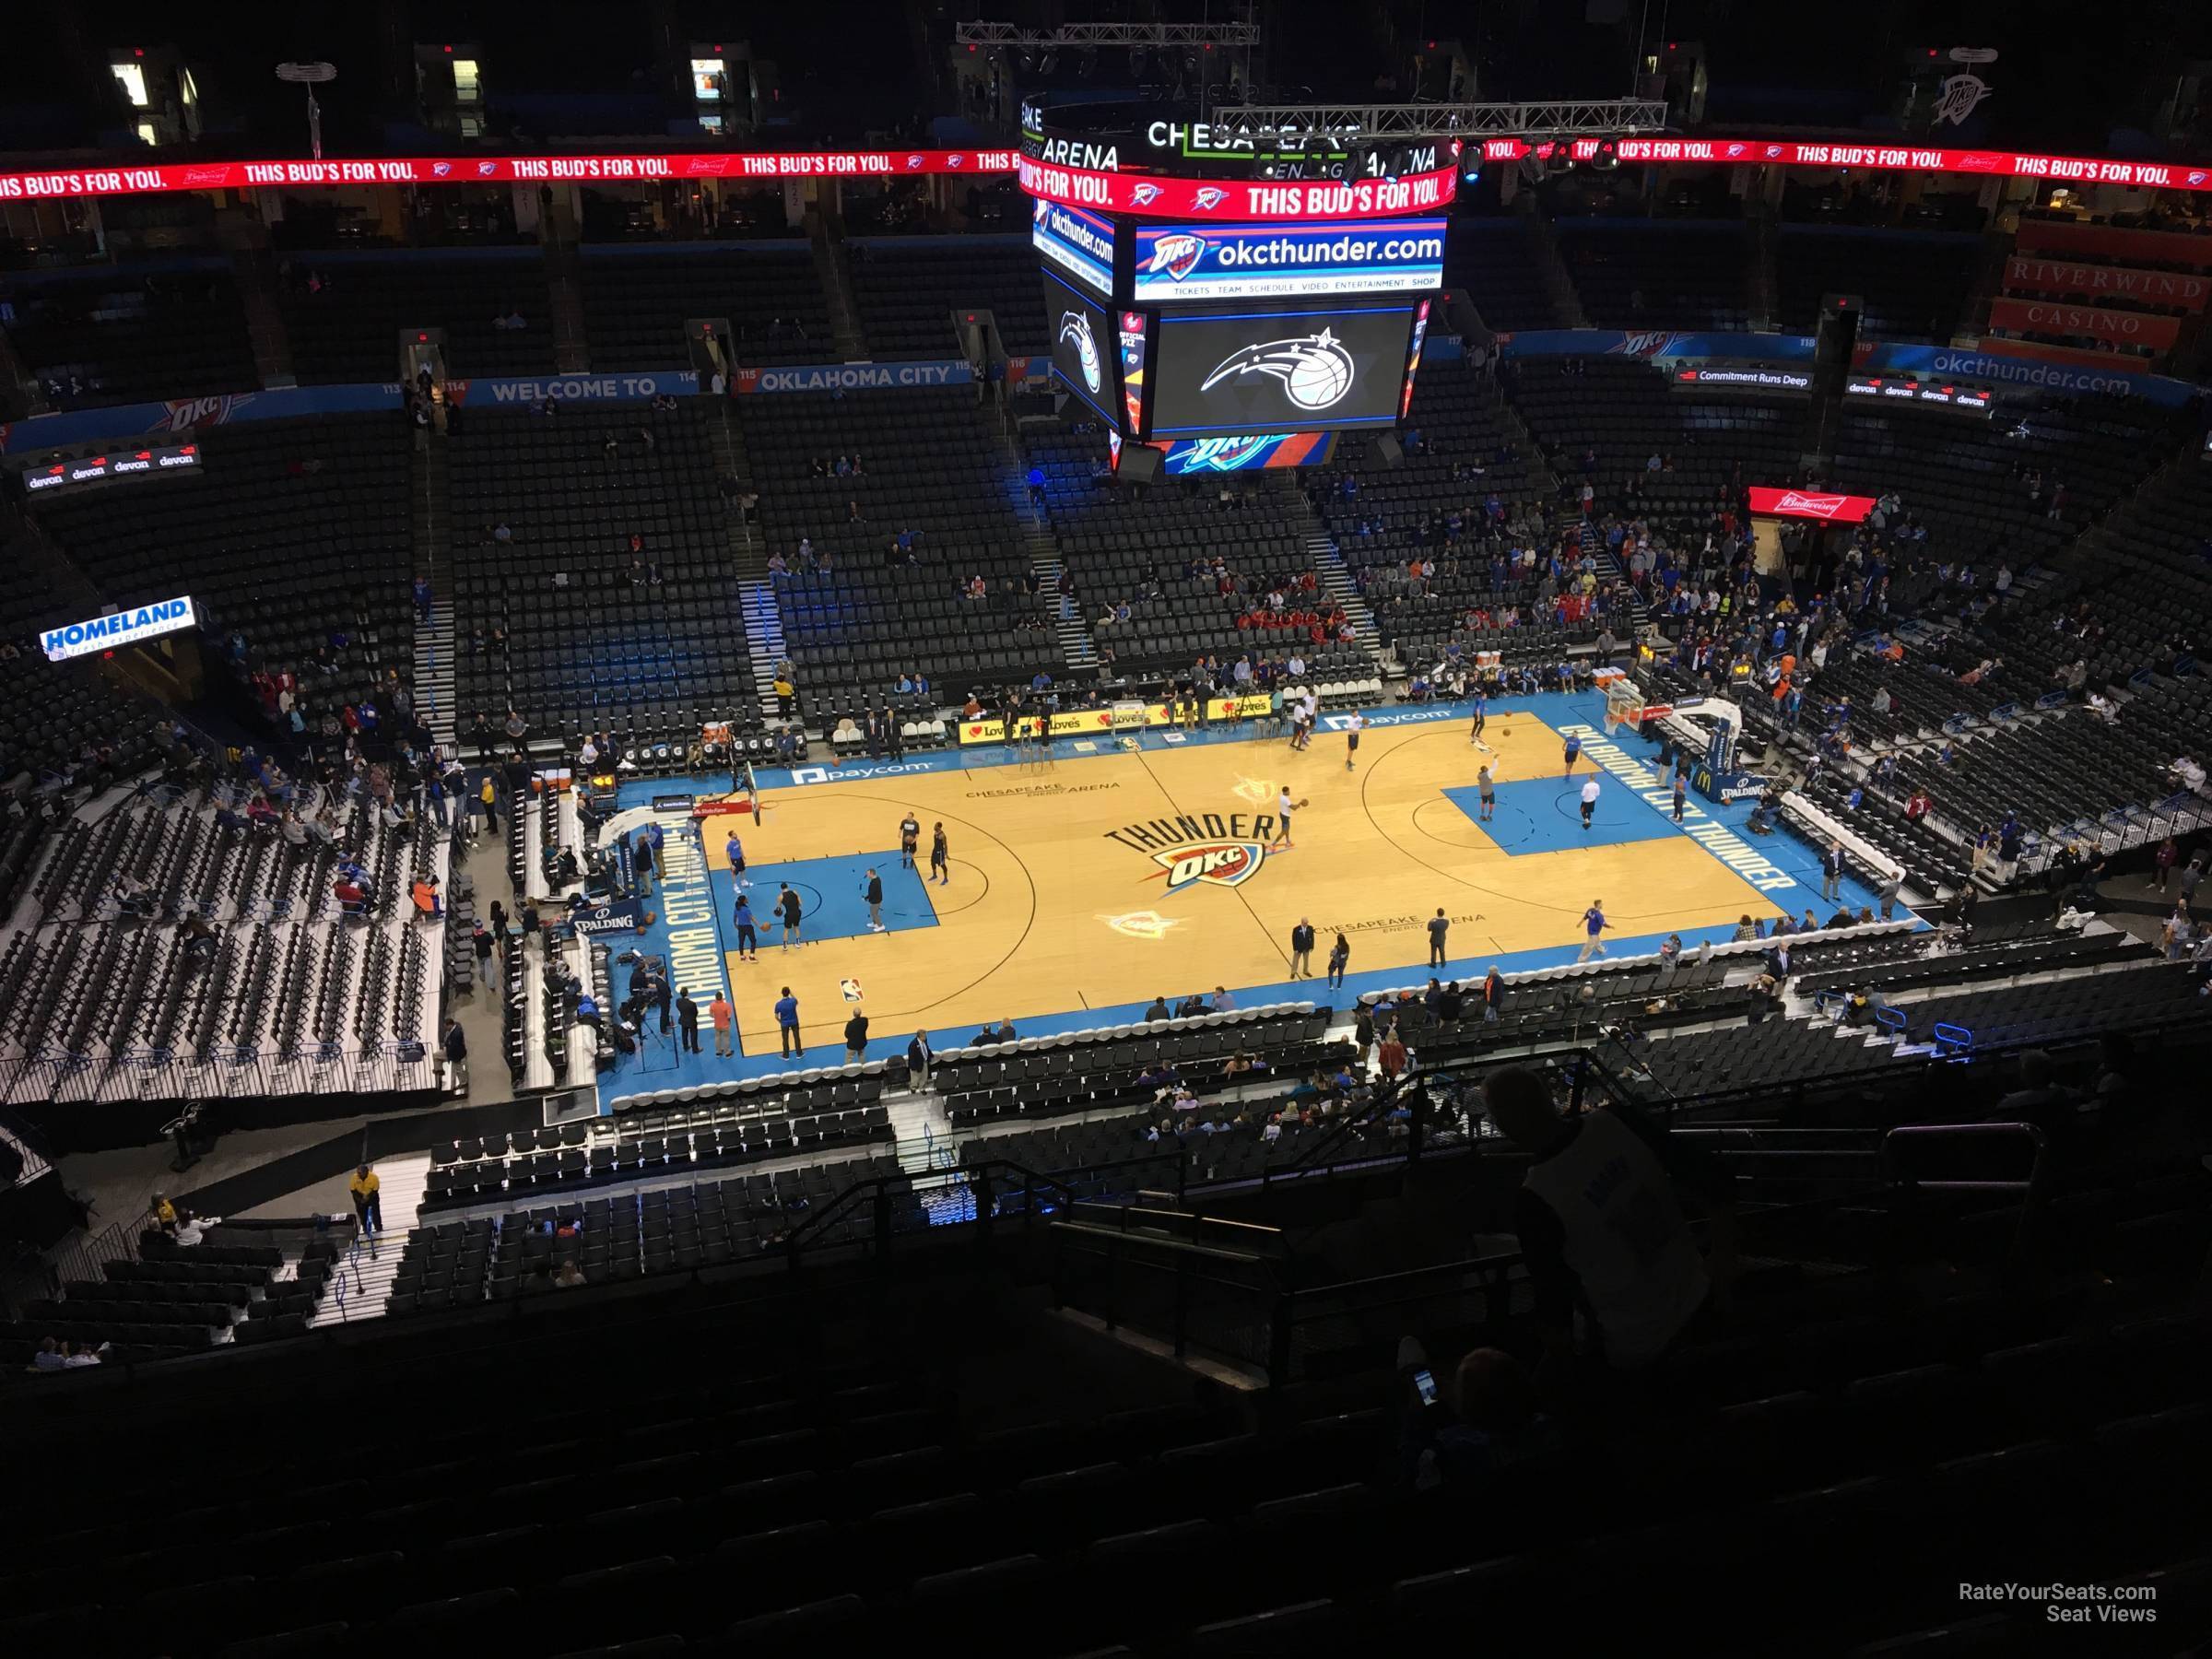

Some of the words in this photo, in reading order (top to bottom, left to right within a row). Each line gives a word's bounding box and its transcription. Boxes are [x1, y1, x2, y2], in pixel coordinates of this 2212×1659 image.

[1042, 137, 1119, 172] ARENA
[1489, 142, 1516, 157] YOU.
[1619, 143, 1651, 158] UD'S
[1653, 143, 1681, 158] FOR
[1685, 144, 1714, 159] YOU.
[1797, 147, 1829, 162] THIS
[1831, 148, 1876, 164] BUD'S
[1878, 150, 1908, 166] FOR
[1912, 152, 1944, 168] YOU.
[512, 160, 548, 177] THIS
[552, 159, 600, 176] BUD'S
[604, 159, 633, 175] FOR
[637, 159, 672, 175] YOU.
[743, 157, 776, 173] THIS
[781, 157, 824, 172] BUD'S
[829, 156, 856, 171] FOR
[860, 156, 893, 171] YOU.
[977, 154, 1008, 170] THIS
[1366, 146, 1435, 176] ANA
[245, 165, 284, 182] THIS
[288, 164, 339, 182] BUD'S
[343, 163, 375, 180] FOR
[379, 162, 418, 180] YOU.
[2016, 158, 2048, 173] THIS
[2051, 160, 2098, 178] BUD'S
[2100, 164, 2132, 181] FOR
[2136, 167, 2171, 184] YOU.
[0, 177, 22, 196] IS
[25, 174, 82, 194] BUD'S
[85, 172, 122, 192] FOR
[124, 171, 167, 188] YOU.
[1043, 169, 1069, 198] FOR
[1071, 174, 1113, 206] YOU.
[1248, 187, 1301, 215] THIS
[1308, 186, 1371, 214] BUD'S
[1376, 183, 1410, 210] FOR
[1414, 177, 1440, 205] YOU.
[1052, 208, 1113, 264] okcthunder.com
[1148, 237, 1197, 273] OKC
[1218, 236, 1442, 266] okcthunder.com
[1174, 286, 1210, 296] TICKETS
[1218, 285, 1242, 294] TEAM
[1249, 283, 1296, 293] SCHEDULE
[1302, 281, 1328, 291] VIDEO
[1335, 278, 1406, 289] ENTERTAINMENT
[1412, 277, 1435, 288] SHOP
[2013, 263, 2201, 298] RIVERWIND
[2028, 306, 2139, 334] CASINO
[1800, 337, 1816, 347] 118
[1856, 343, 1873, 353] 119
[1010, 359, 1026, 369] 116
[1935, 353, 2132, 394] okcthunder.com
[678, 372, 697, 382] 114
[740, 371, 757, 380] 115
[760, 369, 893, 391] OKLAHOMA
[899, 366, 950, 384] CITY
[1700, 371, 1758, 382] Commitment
[1759, 373, 1782, 383] Runs
[1783, 375, 1808, 388] Deep
[382, 383, 400, 394] 113
[492, 378, 618, 402] WELCOME
[622, 378, 656, 395] TO
[1849, 383, 1877, 394] devon
[1886, 387, 1913, 397] devon
[1922, 391, 1949, 402] devon
[1958, 395, 1985, 406] devon
[168, 395, 218, 432] OKC
[115, 461, 149, 472] devon
[159, 455, 194, 466] devon
[29, 475, 64, 488] devon
[73, 466, 105, 480] devon
[1783, 497, 1838, 511] Budweiser
[46, 600, 187, 651] HOMELAND
[70, 640, 104, 656] fresh
[110, 621, 180, 645] experience
[983, 725, 1017, 736] Lovs
[828, 761, 928, 781] paycom
[966, 783, 1063, 798] CHESAPEAKE
[1068, 782, 1121, 794] ARENA
[1721, 784, 1765, 801] SPALDING
[1558, 724, 1663, 790] OKLAHOMA
[1686, 820, 1796, 891] THUNDER
[1103, 814, 1274, 853] THUNDER
[1169, 846, 1242, 887] OKC
[663, 886, 712, 924] CITY
[574, 914, 634, 933] SPALDING
[1313, 915, 1421, 934] CHESAPEAKE
[1451, 913, 1487, 924] ENA
